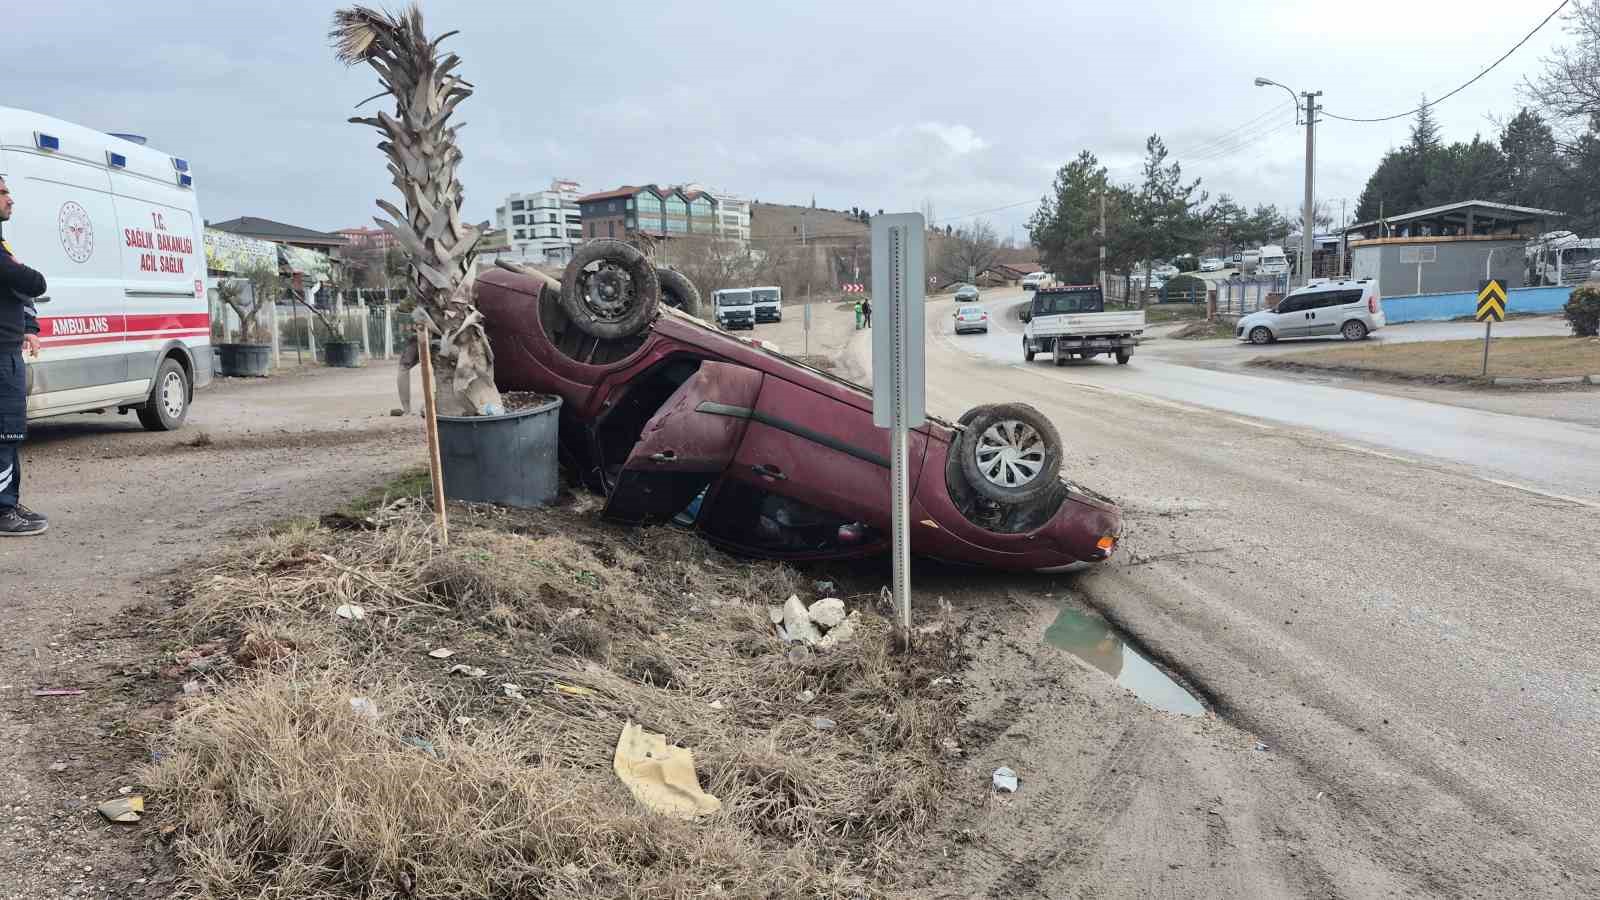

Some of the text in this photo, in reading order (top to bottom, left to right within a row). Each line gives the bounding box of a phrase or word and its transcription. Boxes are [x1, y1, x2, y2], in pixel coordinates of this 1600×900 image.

[125, 227, 154, 250] SAĞLIK
[140, 251, 185, 273] ACİL SAĞLIK
[52, 317, 109, 335] AMBULANS
